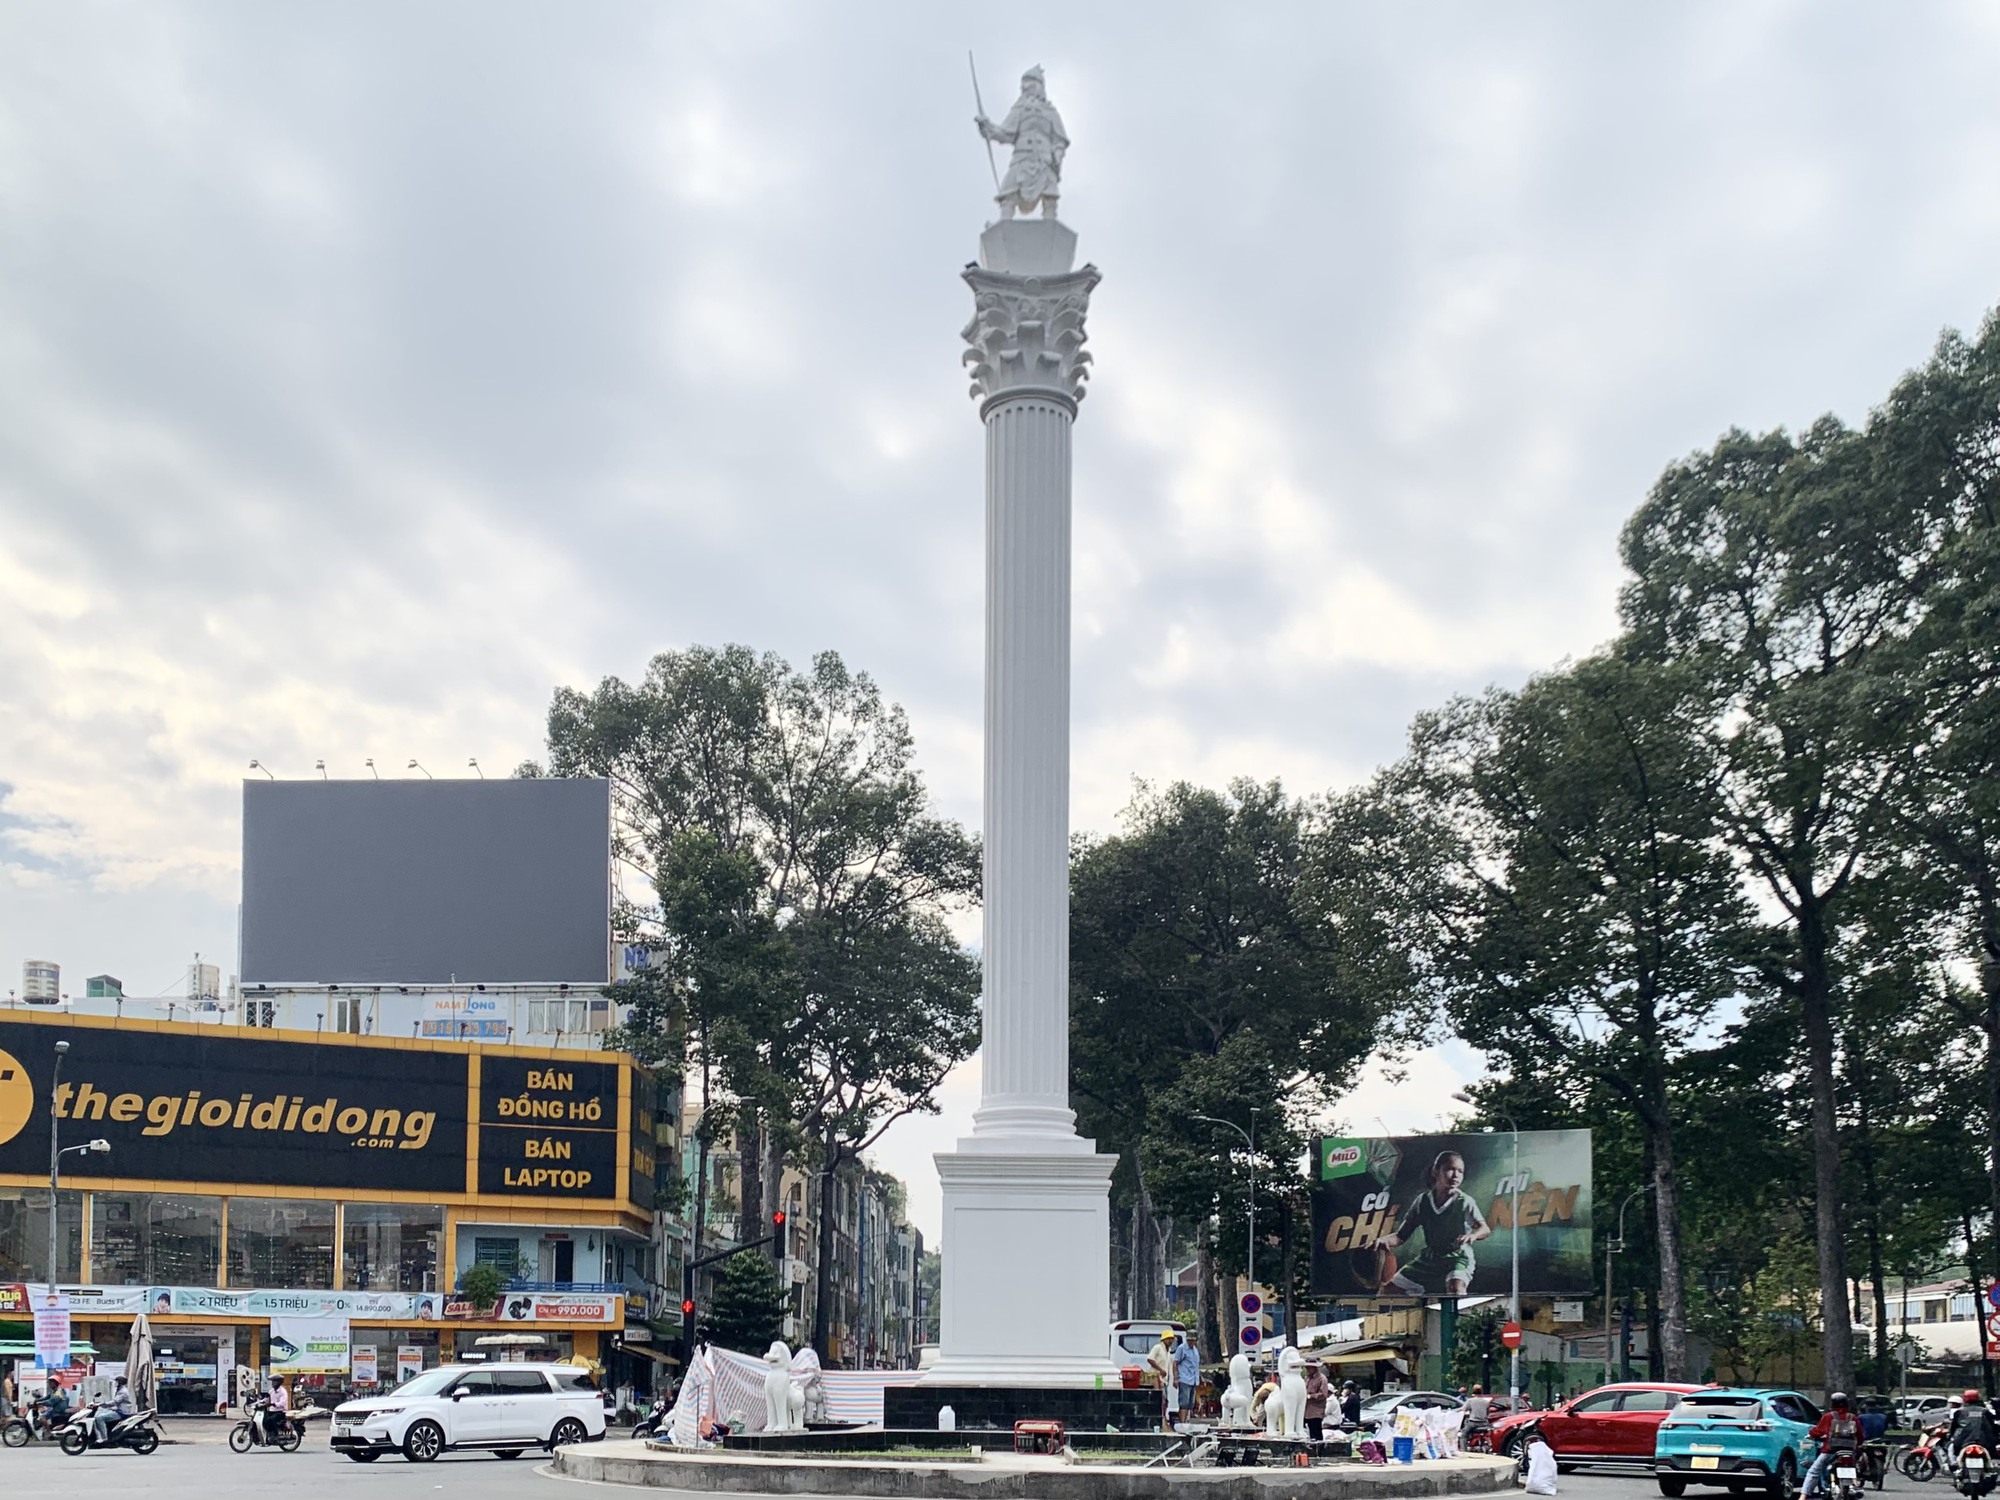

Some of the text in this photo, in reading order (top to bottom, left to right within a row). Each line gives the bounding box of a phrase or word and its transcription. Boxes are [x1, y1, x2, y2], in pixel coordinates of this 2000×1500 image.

[435, 1001, 460, 1010] NAM
[527, 1068, 573, 1091] BÁN
[53, 1082, 436, 1149] thegioididong
[497, 1091, 602, 1121] ĐỒNG HỒ
[350, 1137, 394, 1149] .com
[525, 1137, 571, 1159] BÁN
[1331, 1151, 1358, 1163] MILO
[504, 1167, 592, 1188] LAPTOP
[1361, 1185, 1391, 1212] CÓ
[1488, 1182, 1581, 1232] NÊN
[1324, 1204, 1399, 1253] CHÍ
[199, 1296, 206, 1306] 2
[207, 1295, 238, 1310] TRIỆU
[264, 1299, 277, 1308] 1.5
[280, 1296, 308, 1311] TRIỆU
[557, 1306, 600, 1316] 990.000
